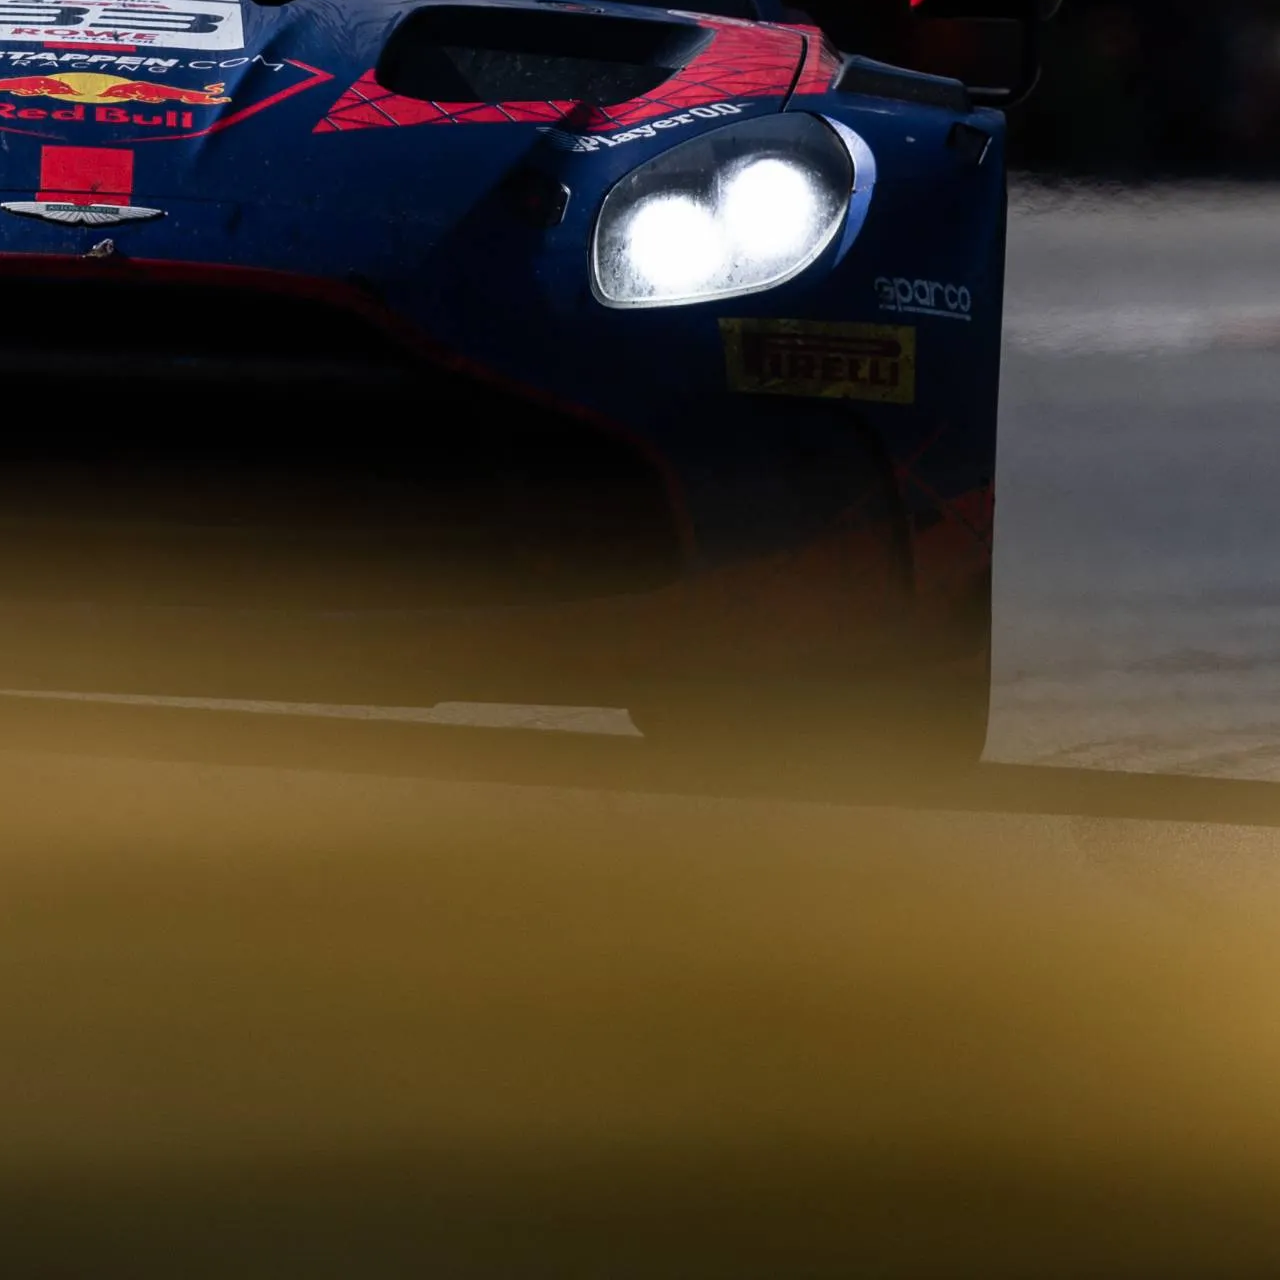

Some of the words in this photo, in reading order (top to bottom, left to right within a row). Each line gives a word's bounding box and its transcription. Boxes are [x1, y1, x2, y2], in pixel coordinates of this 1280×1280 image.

[10, 27, 160, 41] ROWE
[10, 59, 169, 74] RACING
[95, 106, 194, 129] Bull
